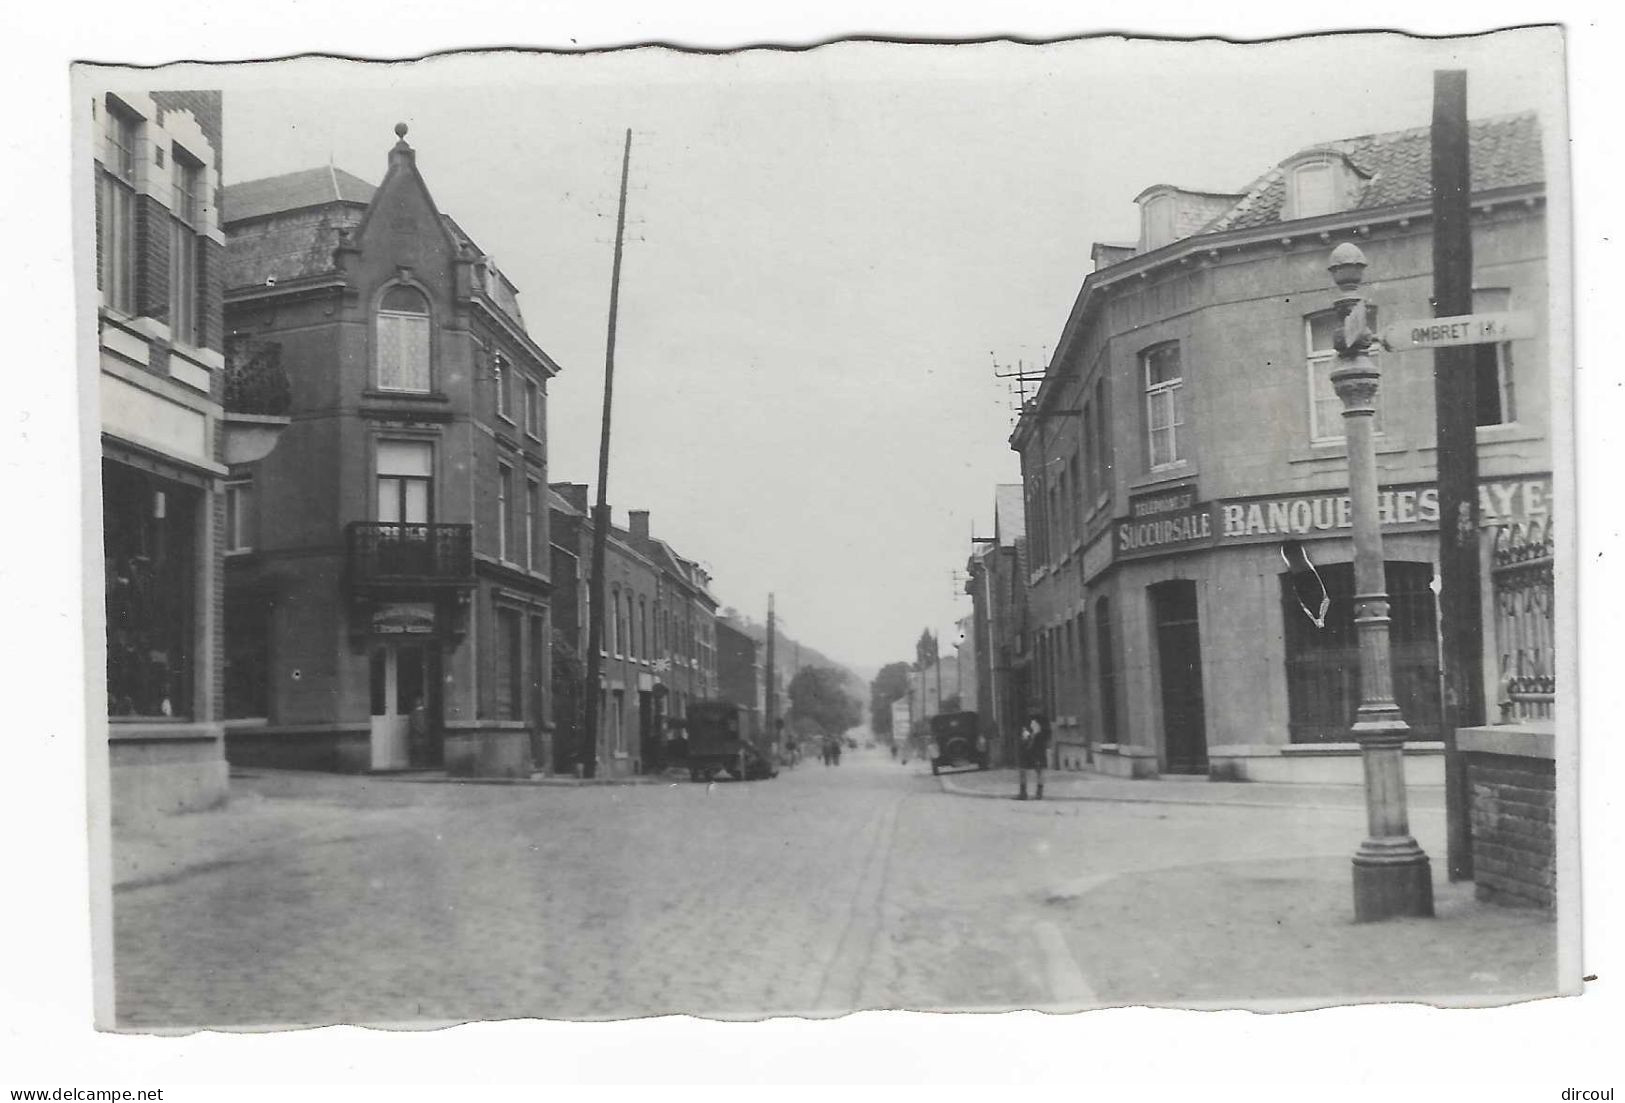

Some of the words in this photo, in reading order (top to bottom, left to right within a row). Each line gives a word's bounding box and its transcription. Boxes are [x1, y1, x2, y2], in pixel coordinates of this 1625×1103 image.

[1411, 322, 1470, 343] OMBRET
[1119, 513, 1212, 551] SUCCURSALE
[1223, 497, 1353, 537] BANQUE
